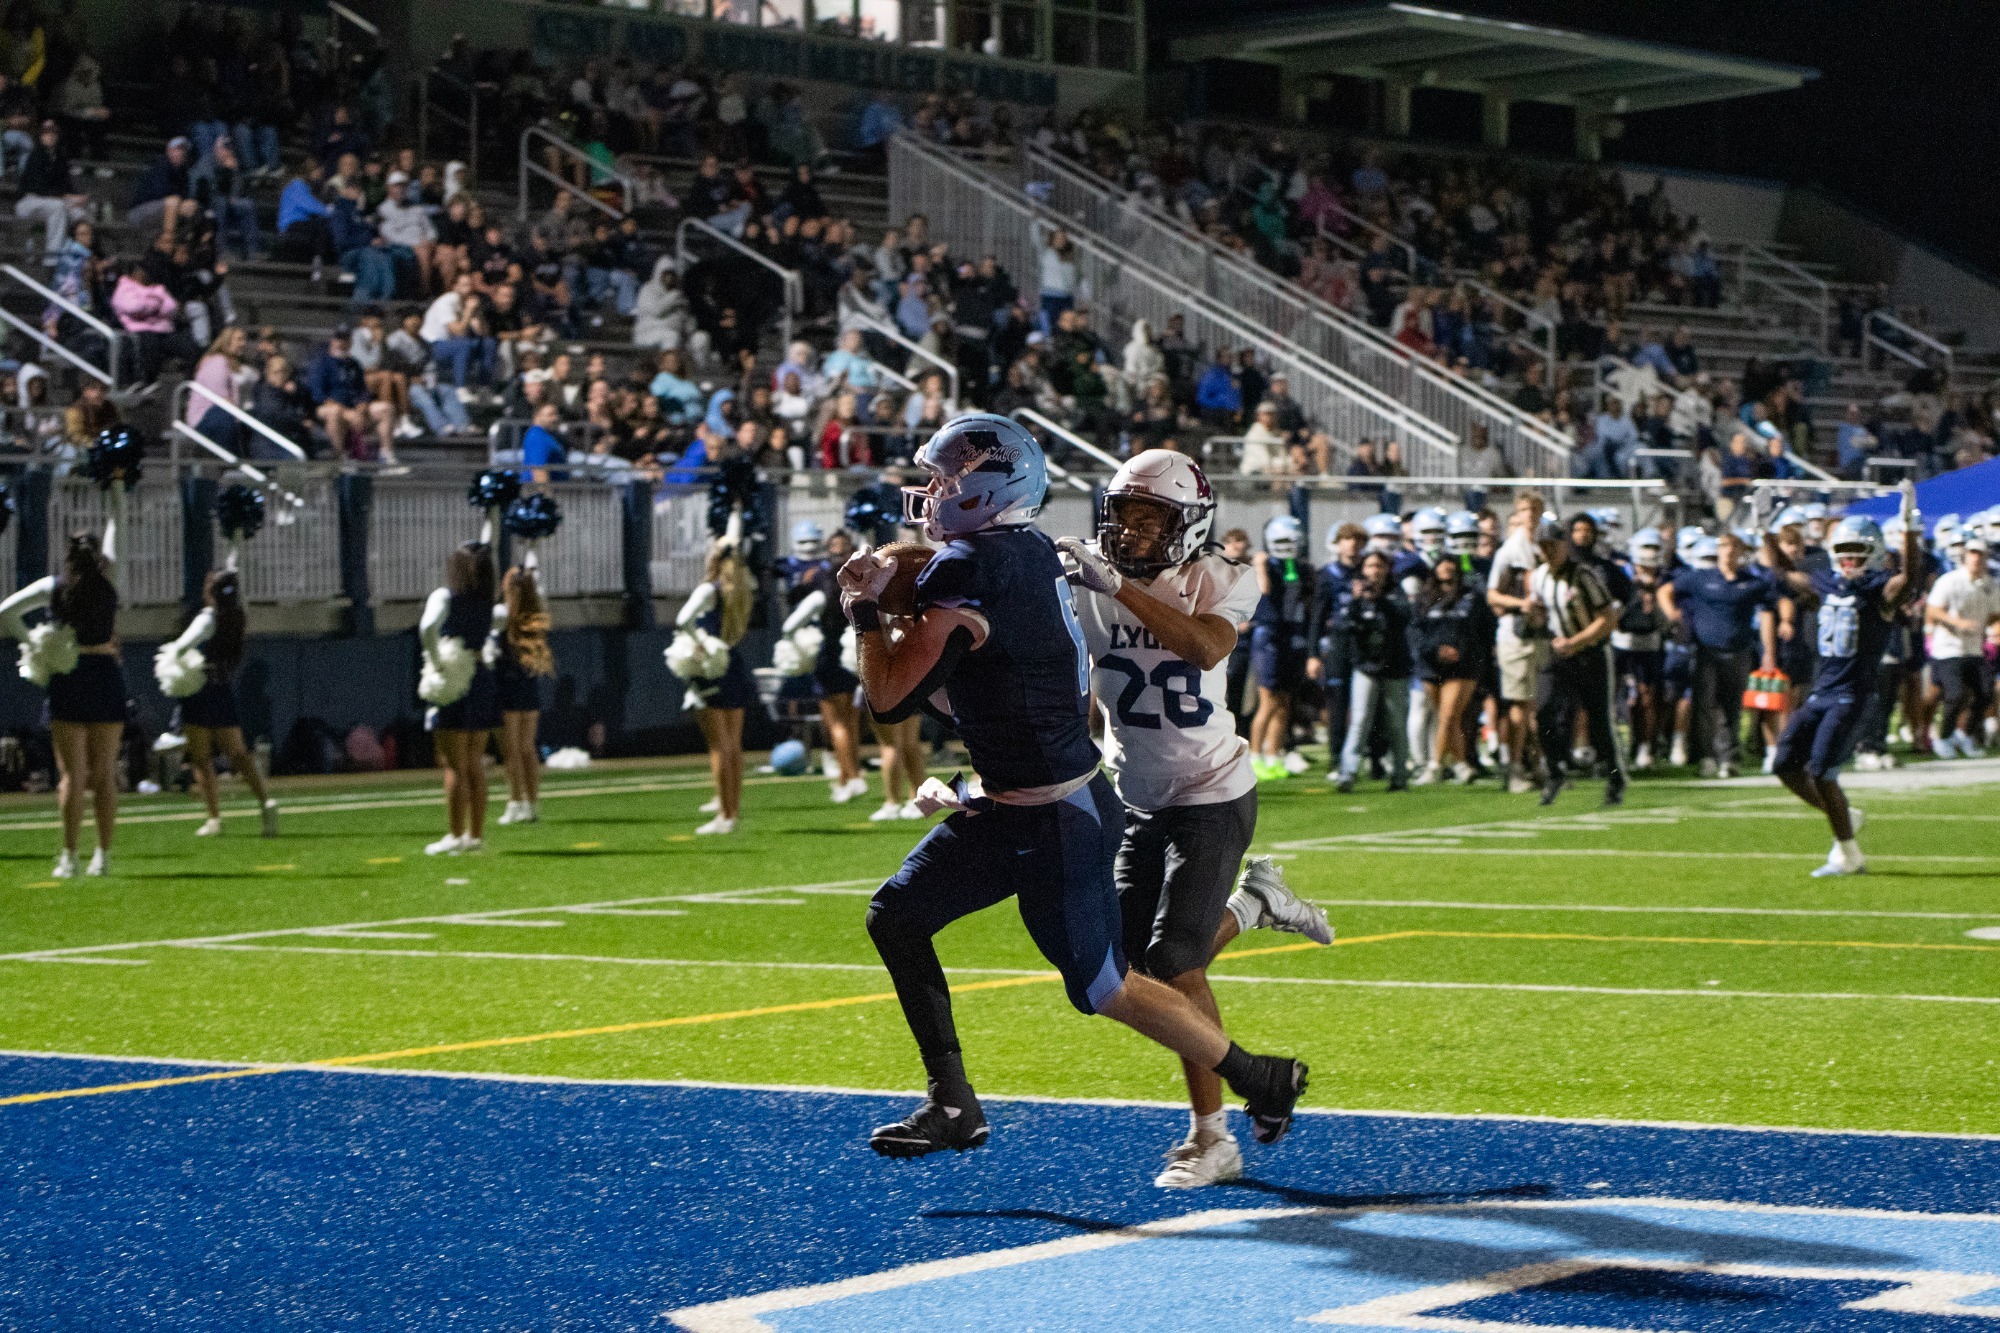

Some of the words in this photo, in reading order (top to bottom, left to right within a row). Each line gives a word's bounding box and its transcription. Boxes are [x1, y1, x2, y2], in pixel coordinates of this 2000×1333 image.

[944, 58, 1058, 105] STADIUM
[1109, 623, 1172, 650] LYO
[1096, 652, 1214, 730] 28
